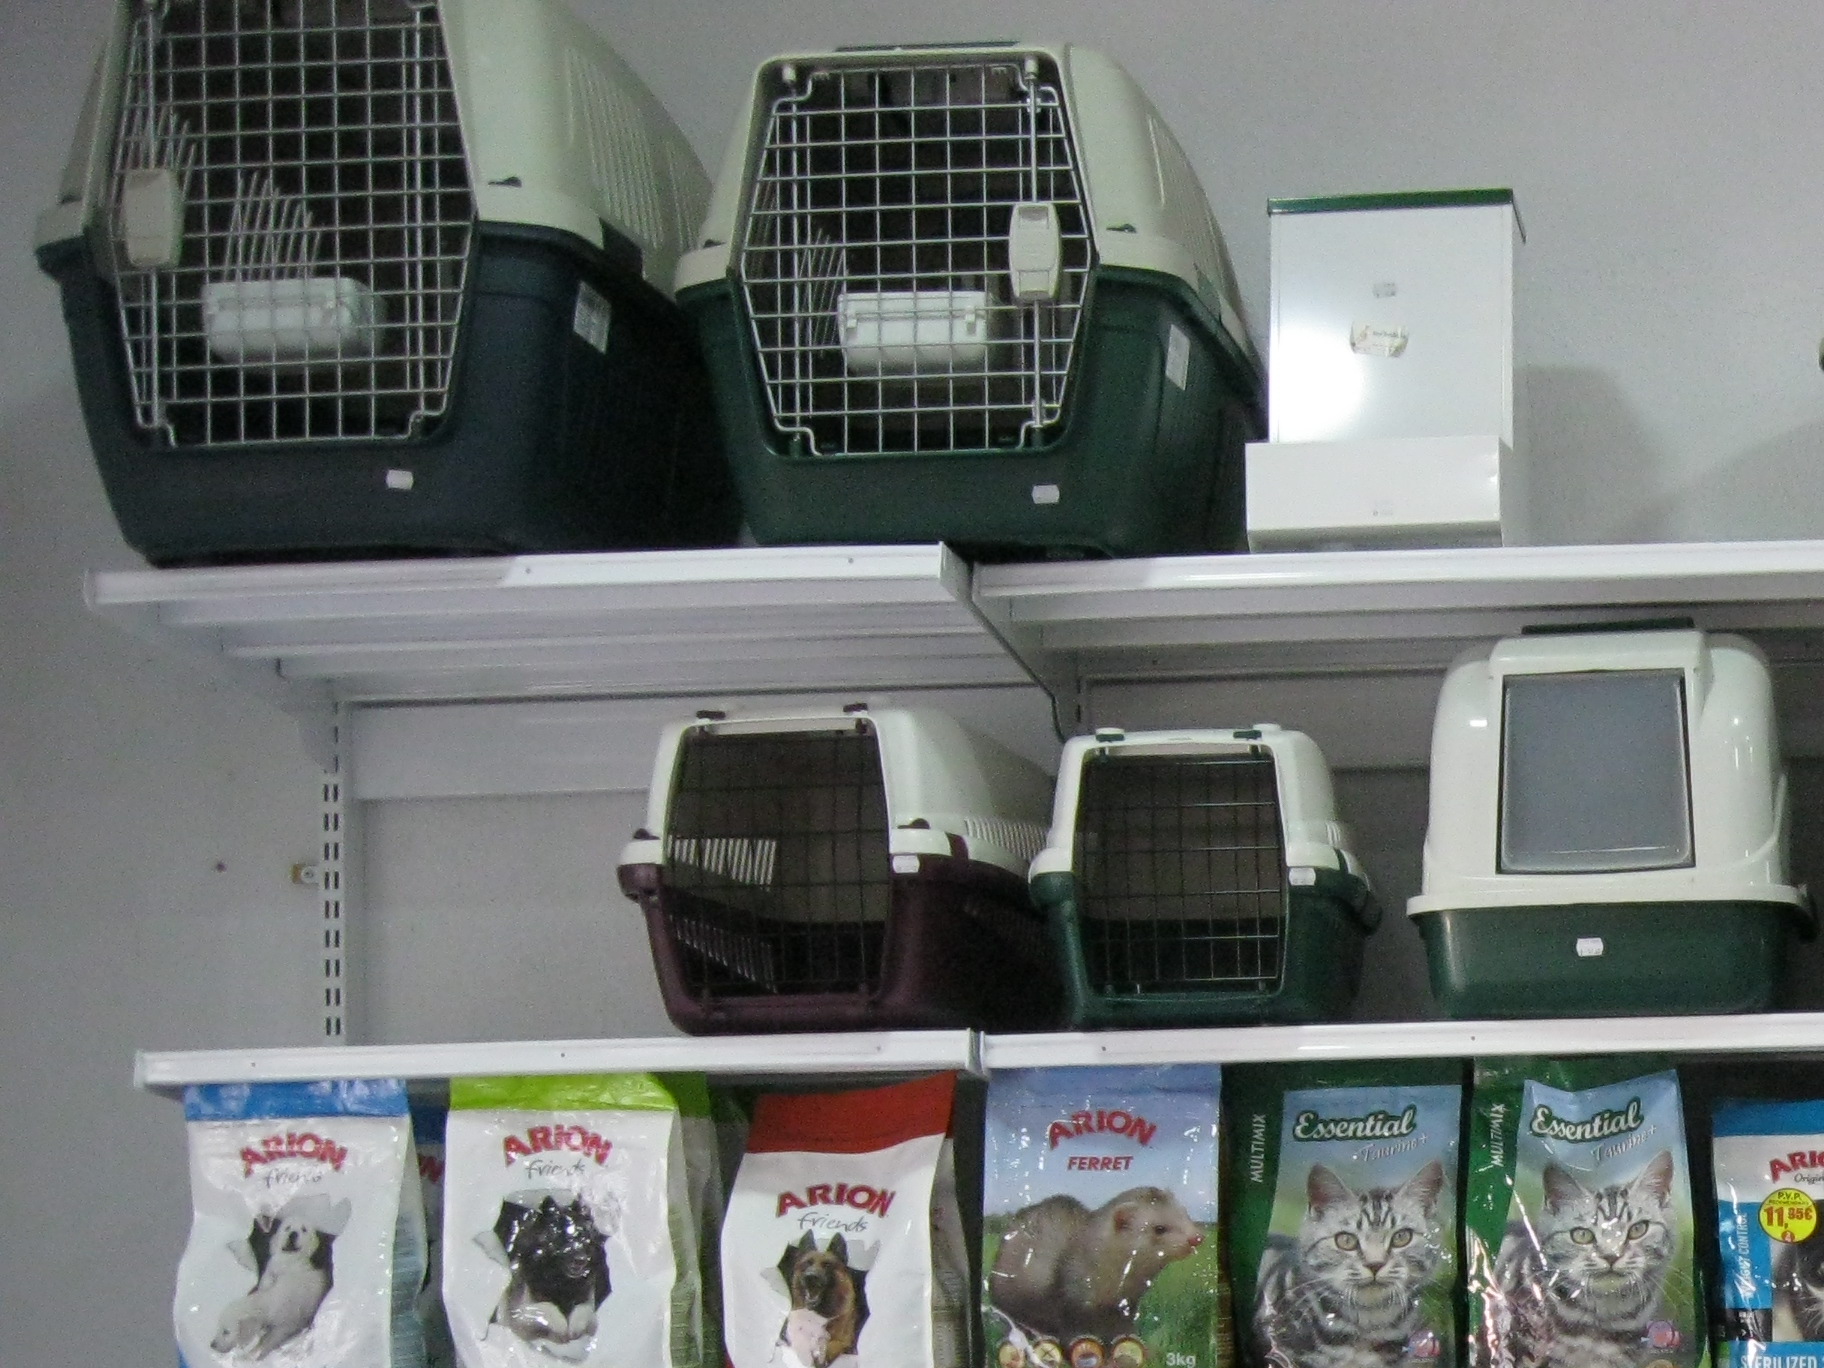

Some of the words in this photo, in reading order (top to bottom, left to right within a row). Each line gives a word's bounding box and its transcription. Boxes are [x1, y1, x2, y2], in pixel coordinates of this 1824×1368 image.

[1048, 1109, 1157, 1149] ARION
[1293, 1103, 1418, 1141] Essential
[1490, 1103, 1507, 1168] MULTIMIX
[1530, 1097, 1643, 1141] Essential
[239, 1132, 348, 1177] ARION
[504, 1125, 613, 1166] ARION
[1067, 1156, 1133, 1171] FERRET
[1249, 1113, 1267, 1183] MULTIMIX
[775, 1183, 896, 1218] ARION
[797, 1211, 868, 1234] friends
[1165, 1352, 1197, 1368] 3kg
